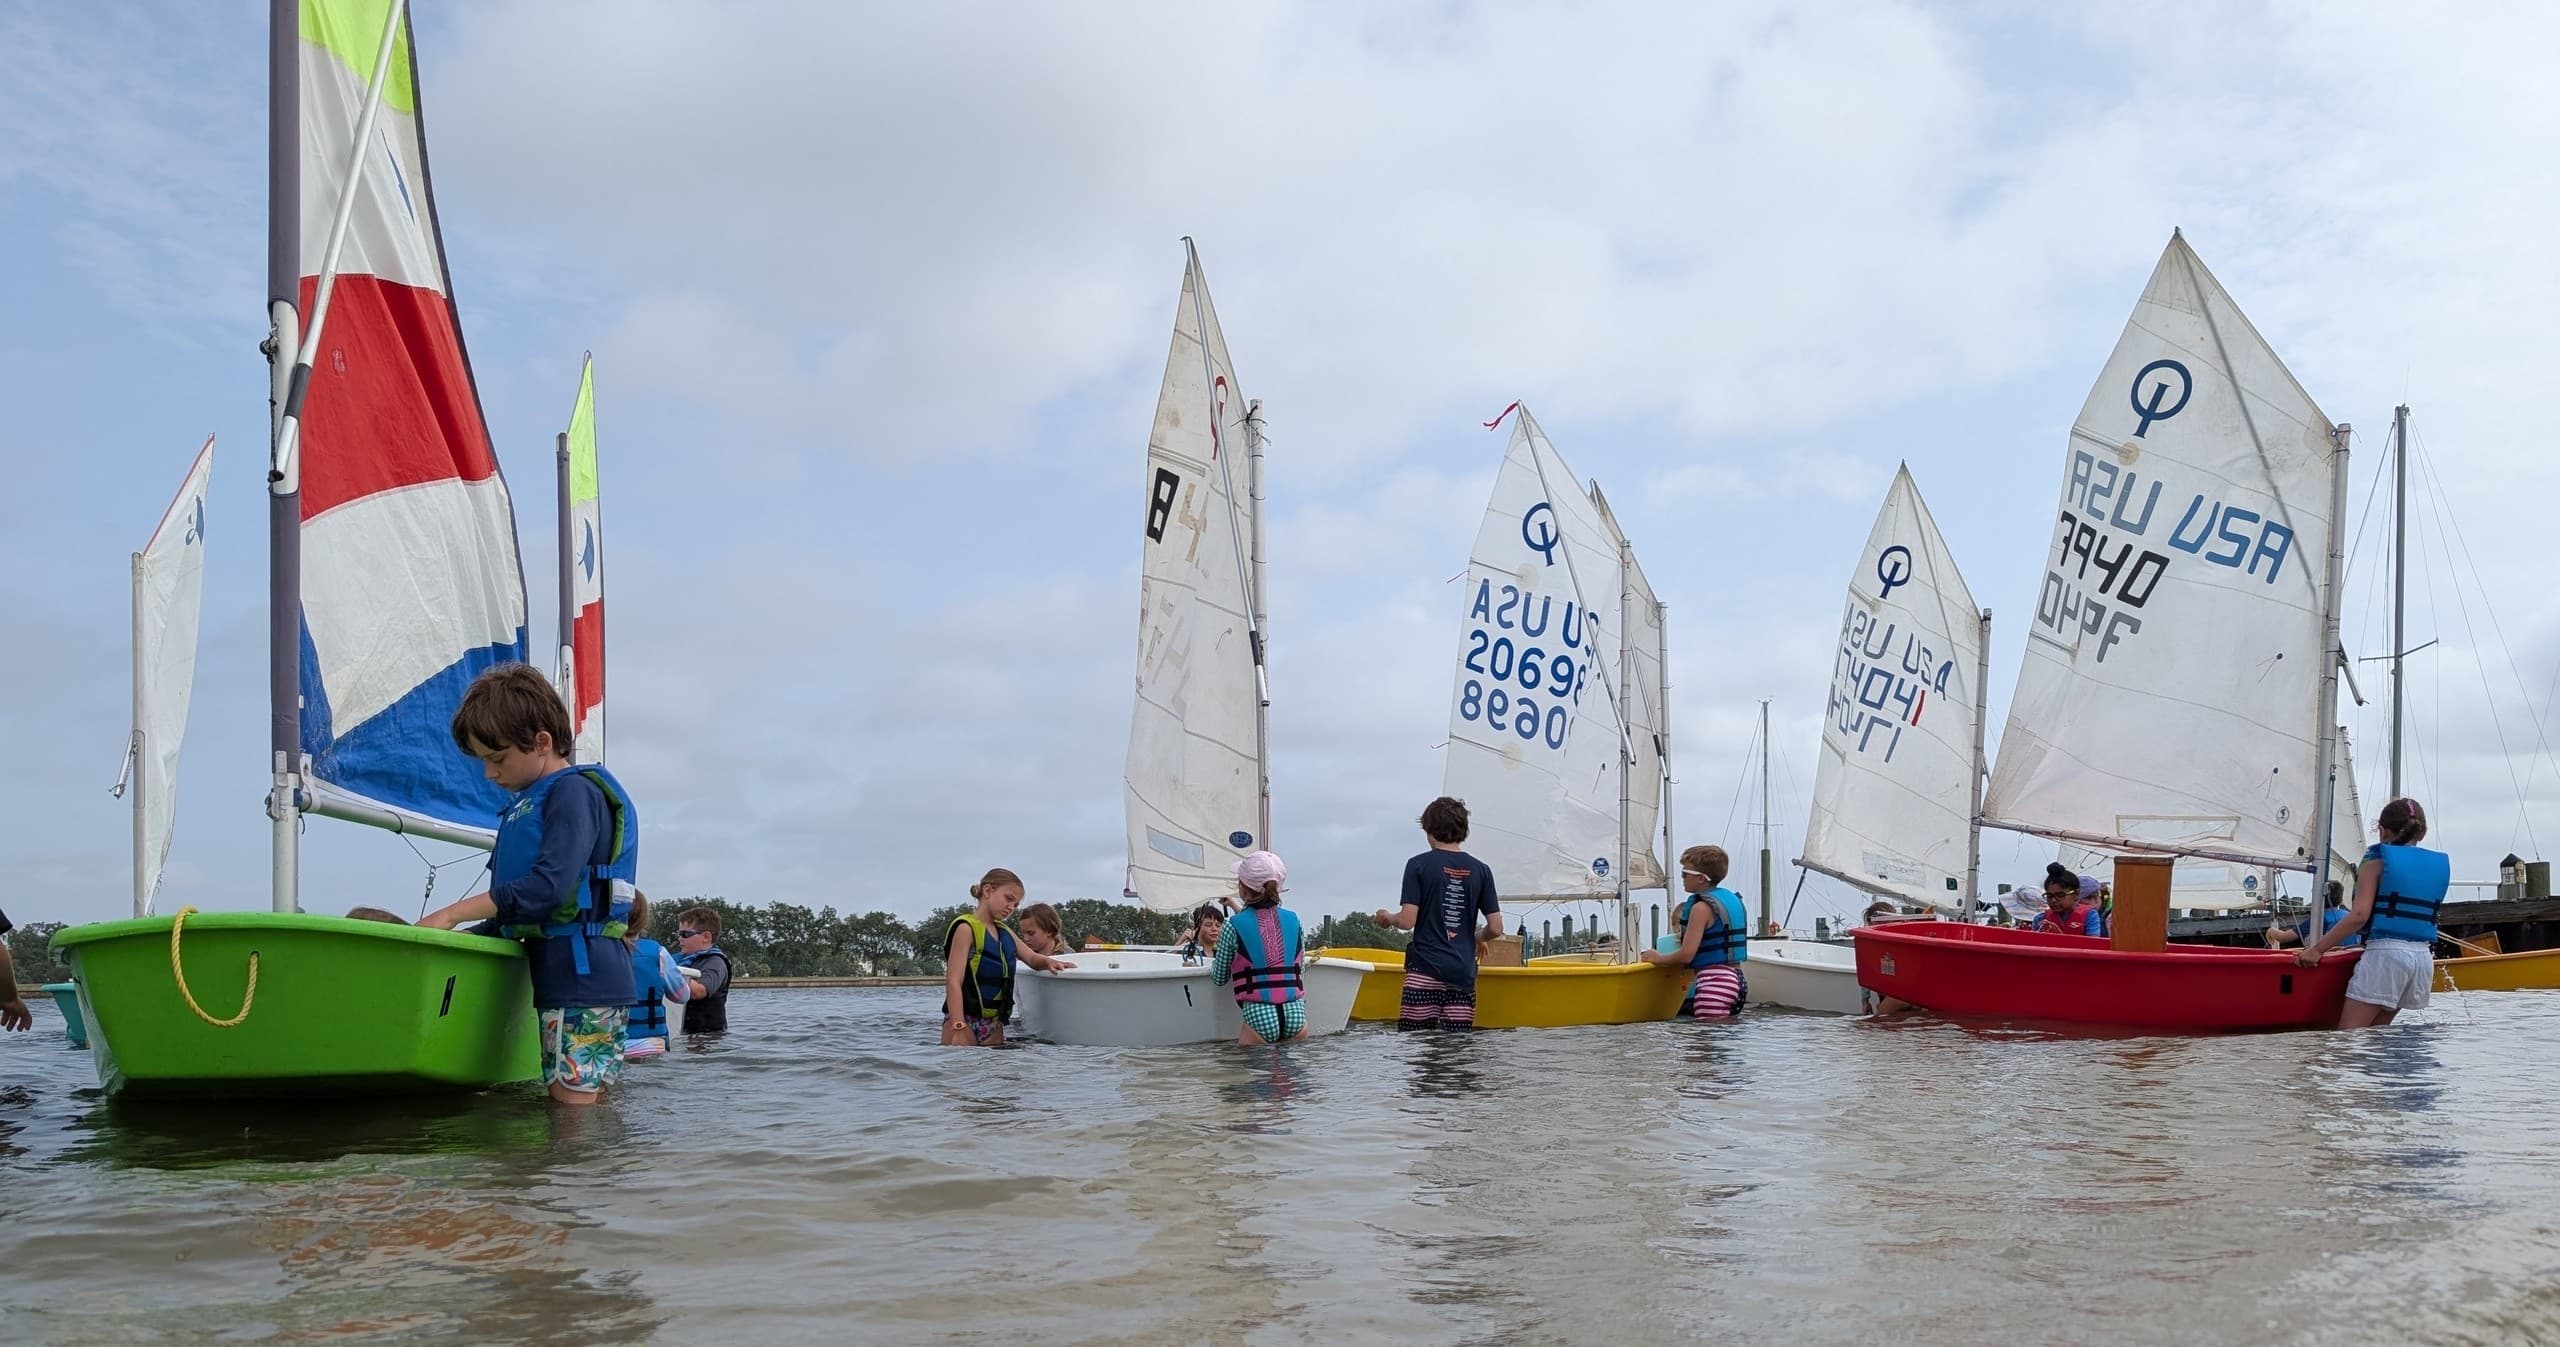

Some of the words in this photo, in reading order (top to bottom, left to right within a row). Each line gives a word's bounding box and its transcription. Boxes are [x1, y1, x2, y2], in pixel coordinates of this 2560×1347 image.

[2061, 510, 2170, 608] 7940
[2167, 494, 2294, 584] USA
[1902, 632, 1953, 701] USA
